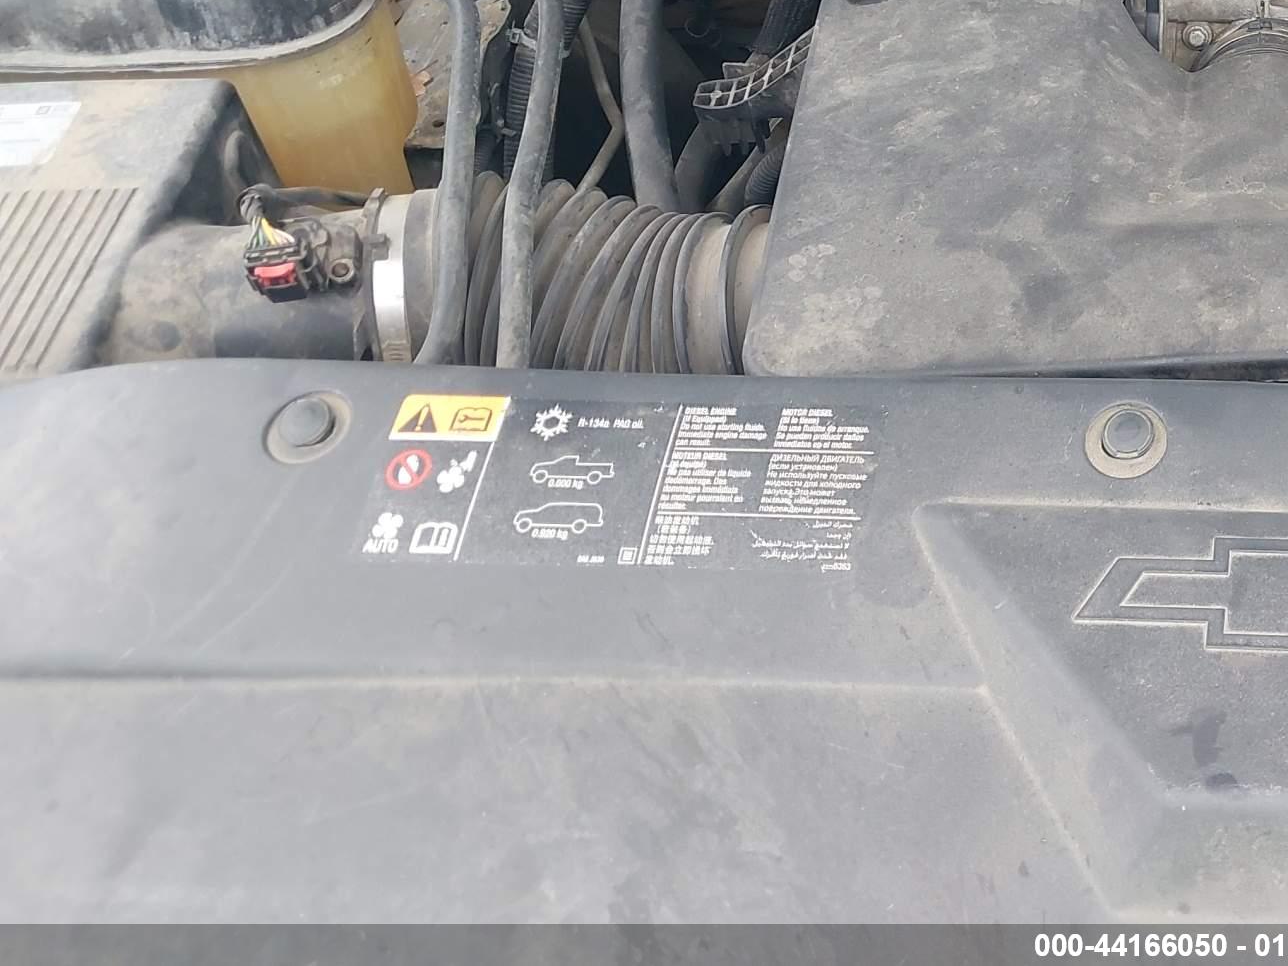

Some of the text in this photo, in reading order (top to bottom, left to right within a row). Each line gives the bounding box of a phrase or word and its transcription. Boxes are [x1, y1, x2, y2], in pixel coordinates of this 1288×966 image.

[685, 407, 709, 415] DIESEL
[577, 417, 610, 428] R-134a
[613, 417, 631, 428] PAG
[717, 424, 743, 432] starting
[739, 432, 767, 440] damage
[813, 433, 842, 441] producir
[770, 454, 864, 463] ДИЗЕЛЬНЫЙ ДВИГАТЕЛЬ
[779, 472, 828, 480] используйте
[572, 480, 584, 490] kg
[556, 529, 568, 540] kg
[362, 539, 399, 553] AUTO
